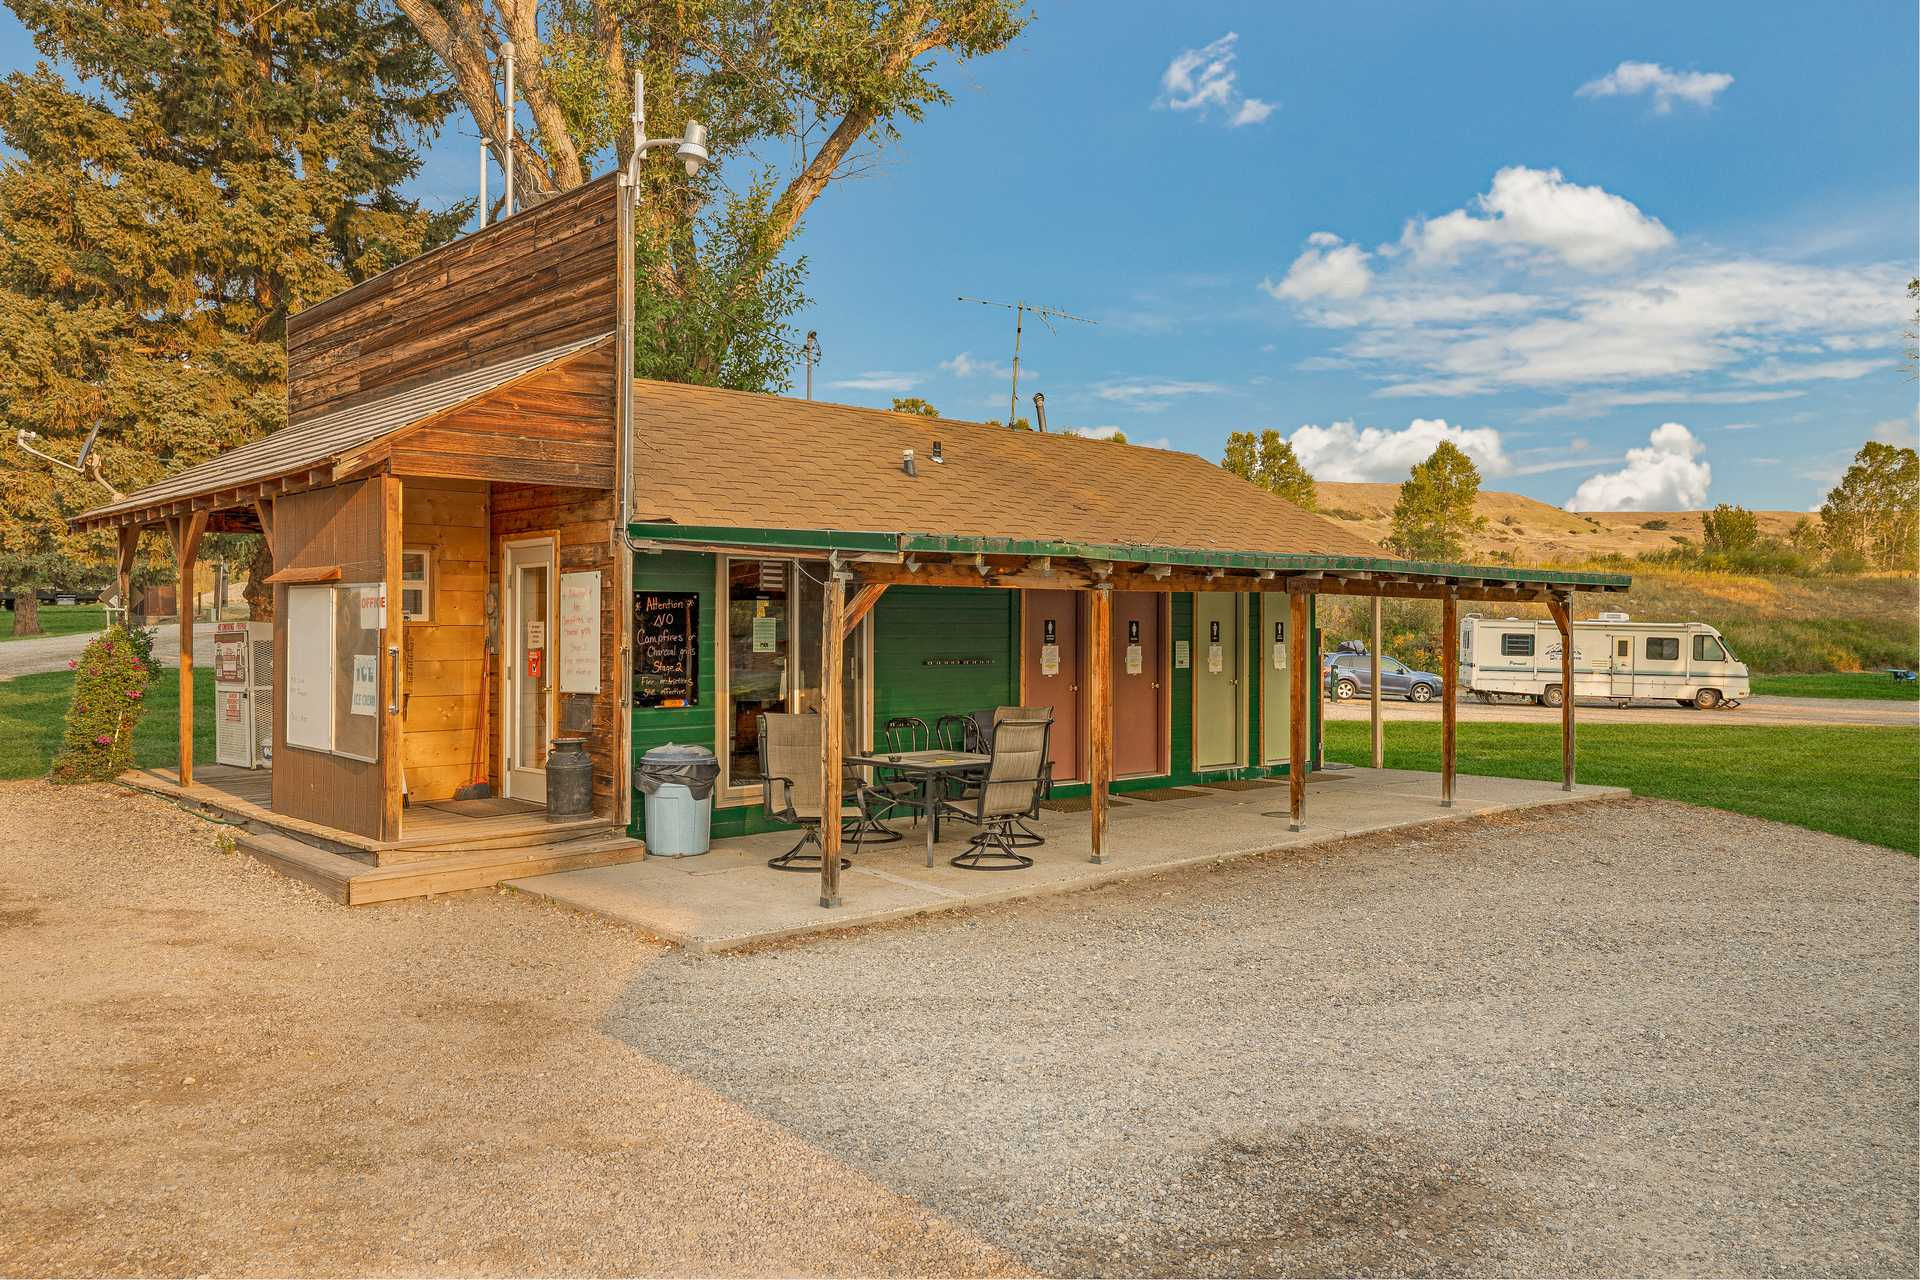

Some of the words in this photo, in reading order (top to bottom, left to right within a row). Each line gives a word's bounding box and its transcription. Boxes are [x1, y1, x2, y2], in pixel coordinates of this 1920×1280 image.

[646, 597, 684, 611] Attention
[654, 614, 674, 626] NO
[637, 629, 684, 645] Campfires
[652, 660, 675, 674] Stage
